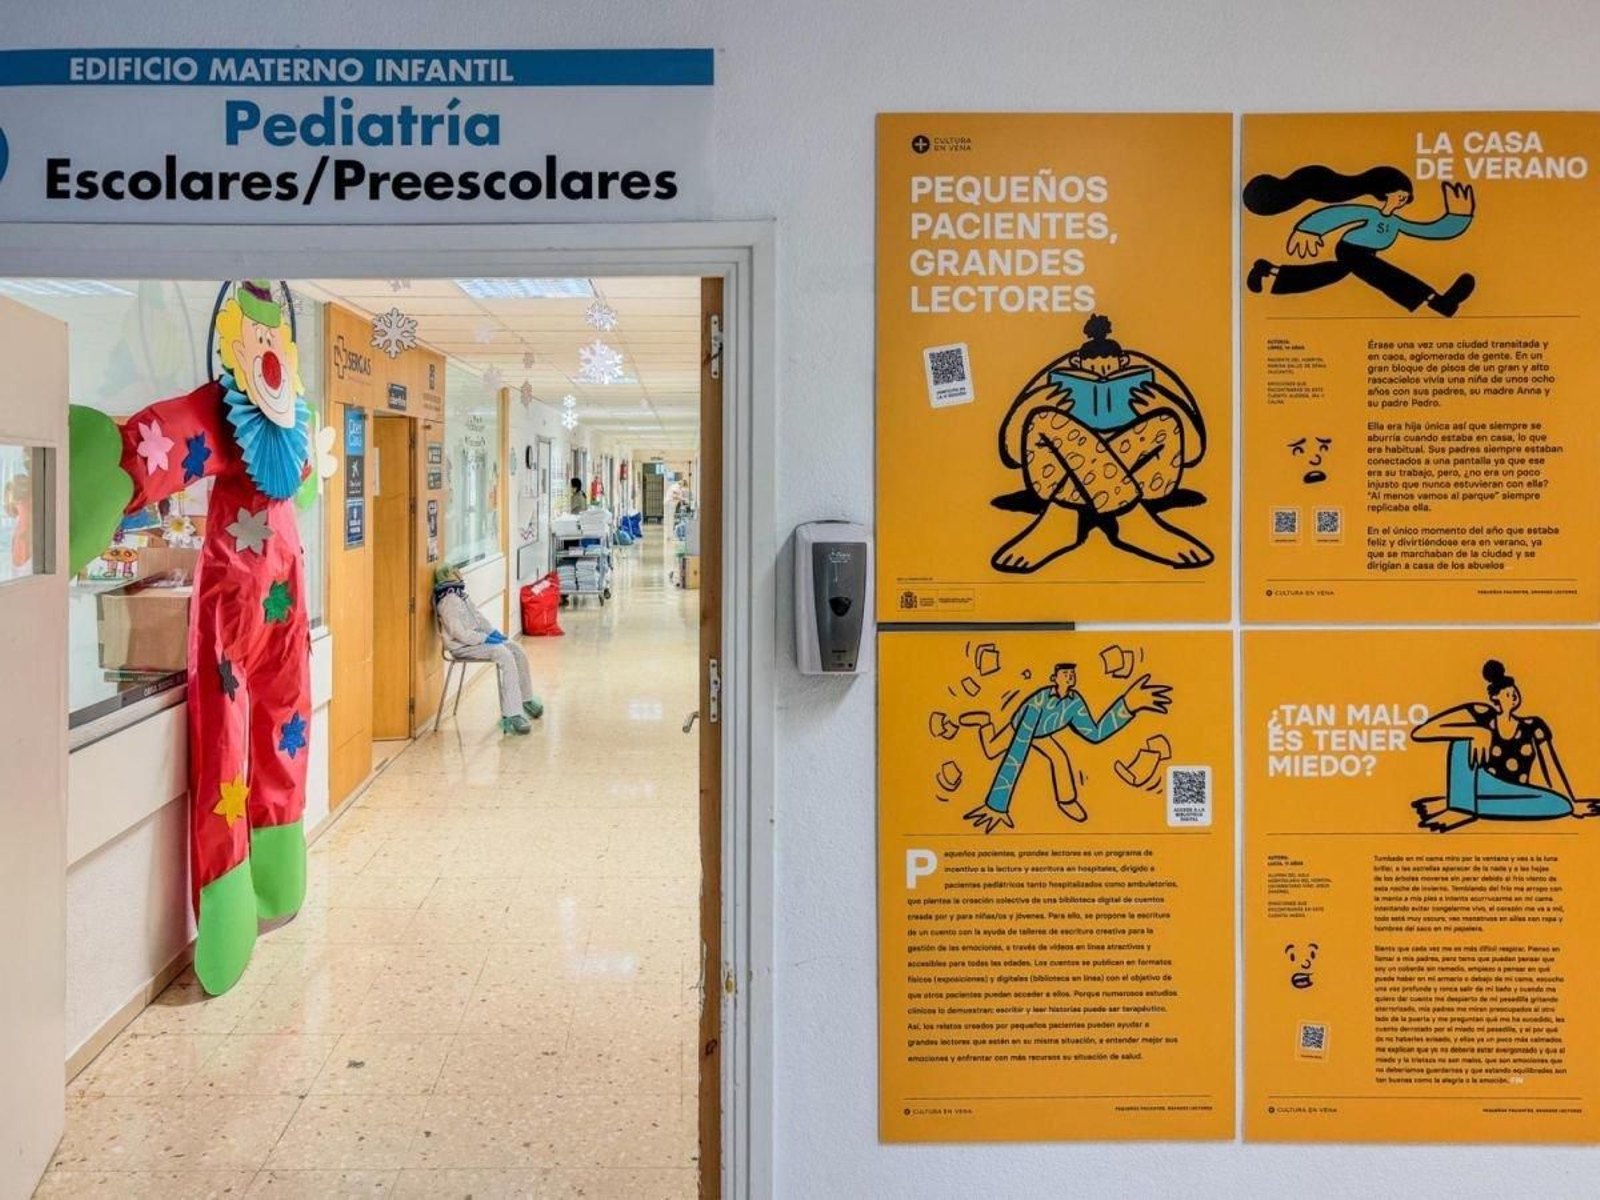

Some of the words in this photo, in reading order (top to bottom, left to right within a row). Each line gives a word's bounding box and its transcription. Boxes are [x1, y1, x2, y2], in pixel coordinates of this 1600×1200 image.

[69, 57, 199, 82] EDIFICIO
[209, 57, 365, 82] MATERNO
[375, 57, 514, 82] INFANTIL
[225, 96, 501, 147] Pediatría
[934, 137, 972, 145] CULTURA
[934, 144, 946, 152] EN
[948, 144, 972, 152] VENA
[1416, 131, 1453, 155] LA
[1464, 131, 1543, 154] CASA
[46, 154, 678, 205] Escolares/Preescolares
[1416, 157, 1453, 180] DE
[1465, 156, 1589, 180] VERANO
[910, 168, 1109, 205] PEQUEÑOS
[910, 212, 1119, 244] PACIENTES,
[910, 248, 1086, 277] GRANDES
[910, 285, 1096, 313] LECTORES
[1368, 340, 1394, 349] Érase
[1456, 340, 1488, 348] ciudad
[1491, 340, 1540, 348] transitada
[1542, 342, 1548, 350] y
[1409, 352, 1465, 362] aglomerada
[1467, 352, 1480, 360] de
[1482, 353, 1512, 362] gente.
[1515, 351, 1528, 360] En
[1367, 366, 1389, 374] gran
[1392, 364, 1424, 374] bloque
[1426, 364, 1438, 372] de
[1440, 364, 1466, 373] pisos
[1468, 364, 1480, 372] de
[1497, 365, 1520, 374] gran
[1522, 365, 1528, 373] y
[1368, 376, 1421, 384] rascacielos
[1422, 376, 1444, 384] vivía
[1468, 375, 1488, 383] niña
[1490, 375, 1503, 383] de
[1531, 375, 1555, 383] ocho
[1368, 388, 1390, 396] años
[1432, 388, 1466, 397] padres,
[1484, 387, 1514, 395] madre
[1544, 388, 1550, 396] y
[1381, 400, 1408, 408] padre
[1412, 399, 1440, 407] Pedro.
[1367, 526, 1379, 535] En
[1382, 526, 1391, 535] el
[1392, 526, 1419, 535] único
[1469, 526, 1484, 534] del
[1486, 526, 1504, 534] año
[1506, 528, 1524, 536] que
[1367, 538, 1387, 546] feliz
[1389, 540, 1395, 548] y
[1397, 538, 1458, 546] divirtiéndose
[1531, 540, 1542, 548] ya
[1367, 552, 1384, 560] que
[1401, 550, 1454, 558] marchaban
[1455, 550, 1468, 558] de
[1470, 550, 1479, 558] la
[1481, 550, 1513, 558] ciudad
[1516, 552, 1522, 560] y
[1367, 561, 1402, 571] dirigían
[1451, 561, 1465, 570] los
[1468, 561, 1504, 569] abuelos
[1267, 704, 1335, 729] ¿TAN
[1348, 703, 1429, 726] MALO
[1268, 729, 1303, 752] ES
[1313, 729, 1408, 752] TENER
[1268, 754, 1377, 778] MIEDO?
[906, 848, 938, 889] P
